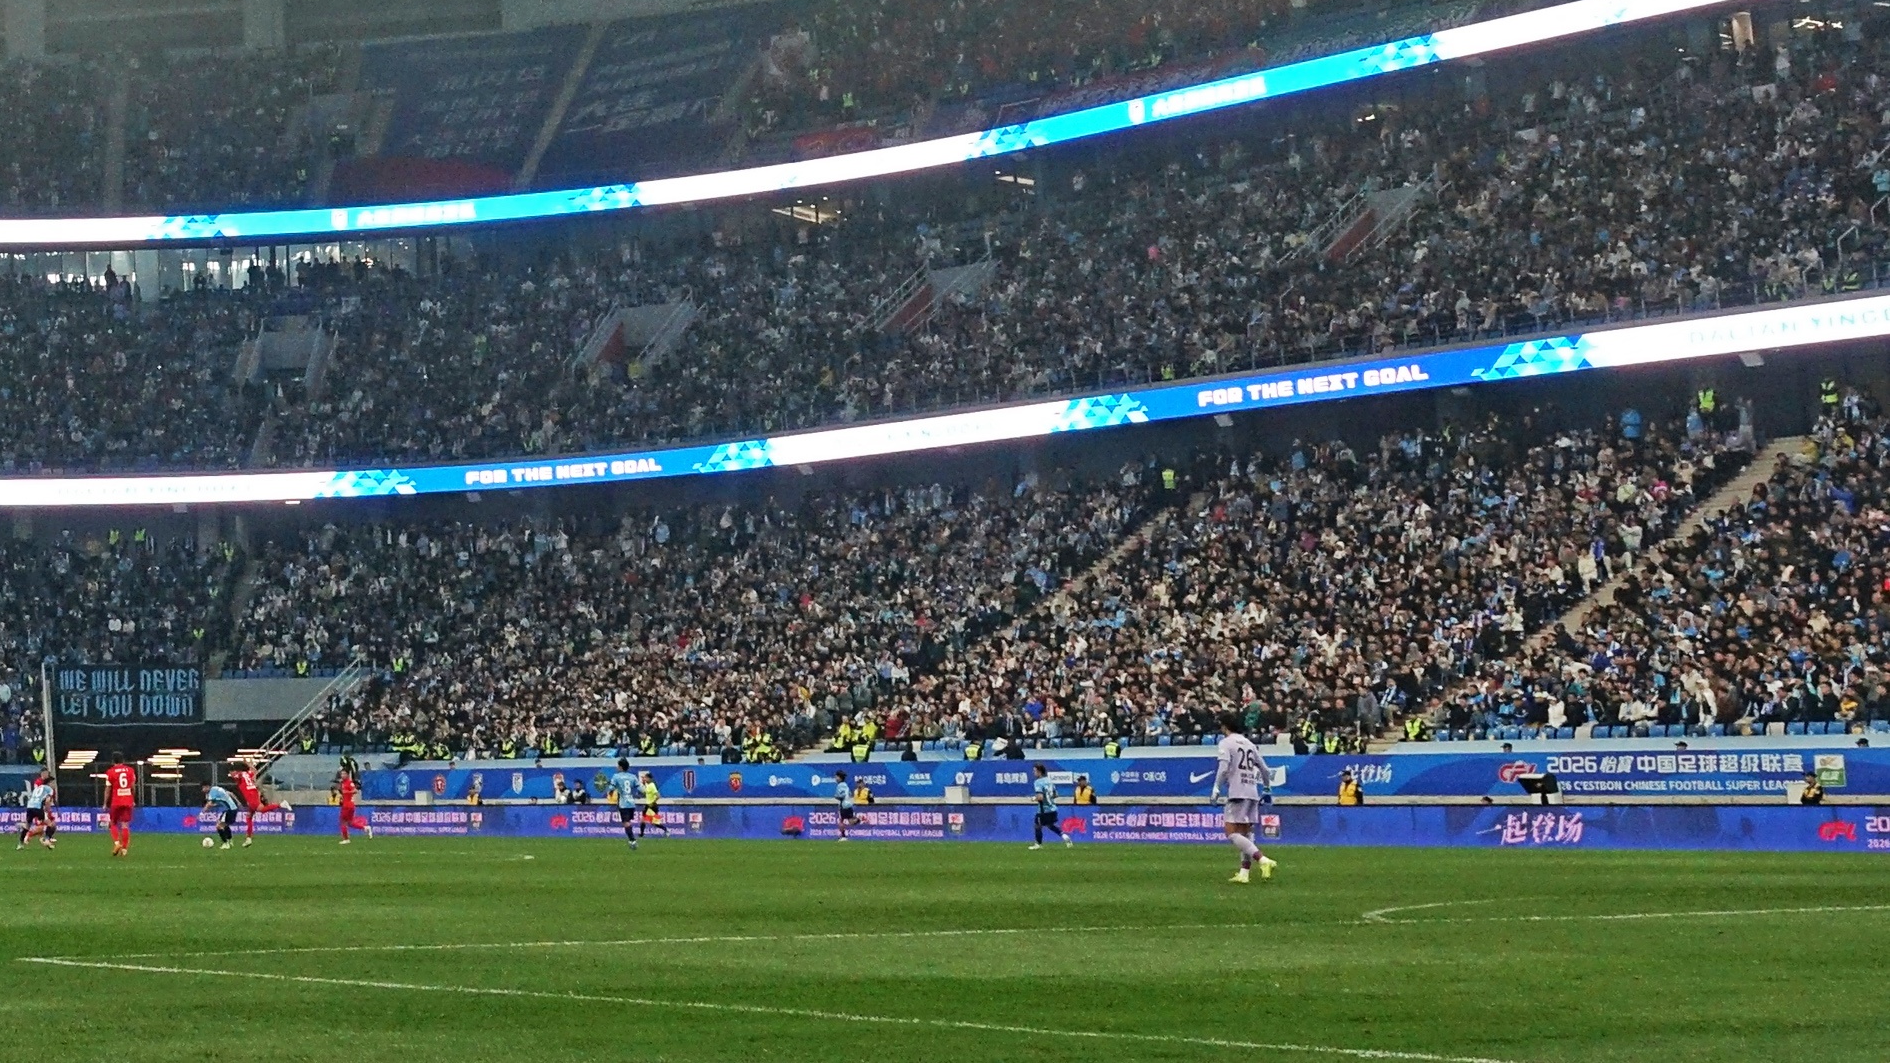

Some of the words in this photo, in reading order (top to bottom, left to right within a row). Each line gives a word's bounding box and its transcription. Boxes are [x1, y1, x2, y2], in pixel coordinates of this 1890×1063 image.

[1198, 389, 1243, 407] FOR
[1246, 381, 1294, 401] THE
[1297, 372, 1359, 395] NEXT
[1362, 364, 1429, 386] GOAL
[465, 469, 508, 485] FOR
[511, 466, 553, 483] THE
[556, 462, 608, 479] NEXT
[611, 458, 662, 474] GOAL
[60, 669, 87, 692] WE
[91, 669, 135, 693] WILL
[139, 668, 200, 692] NEVER
[60, 694, 90, 718] LET
[95, 694, 133, 719] YOU
[139, 693, 194, 718] DOWN
[1237, 747, 1256, 771] 26
[119, 772, 128, 788] 6
[624, 780, 631, 794] 8
[1574, 780, 1622, 791] C'ESTBON
[1624, 780, 1667, 791] CHINESE
[1669, 779, 1723, 791] FOOTBALL
[1725, 779, 1761, 790] SUPER
[1476, 811, 1583, 845] 一起登场
[1865, 816, 1890, 833] 20
